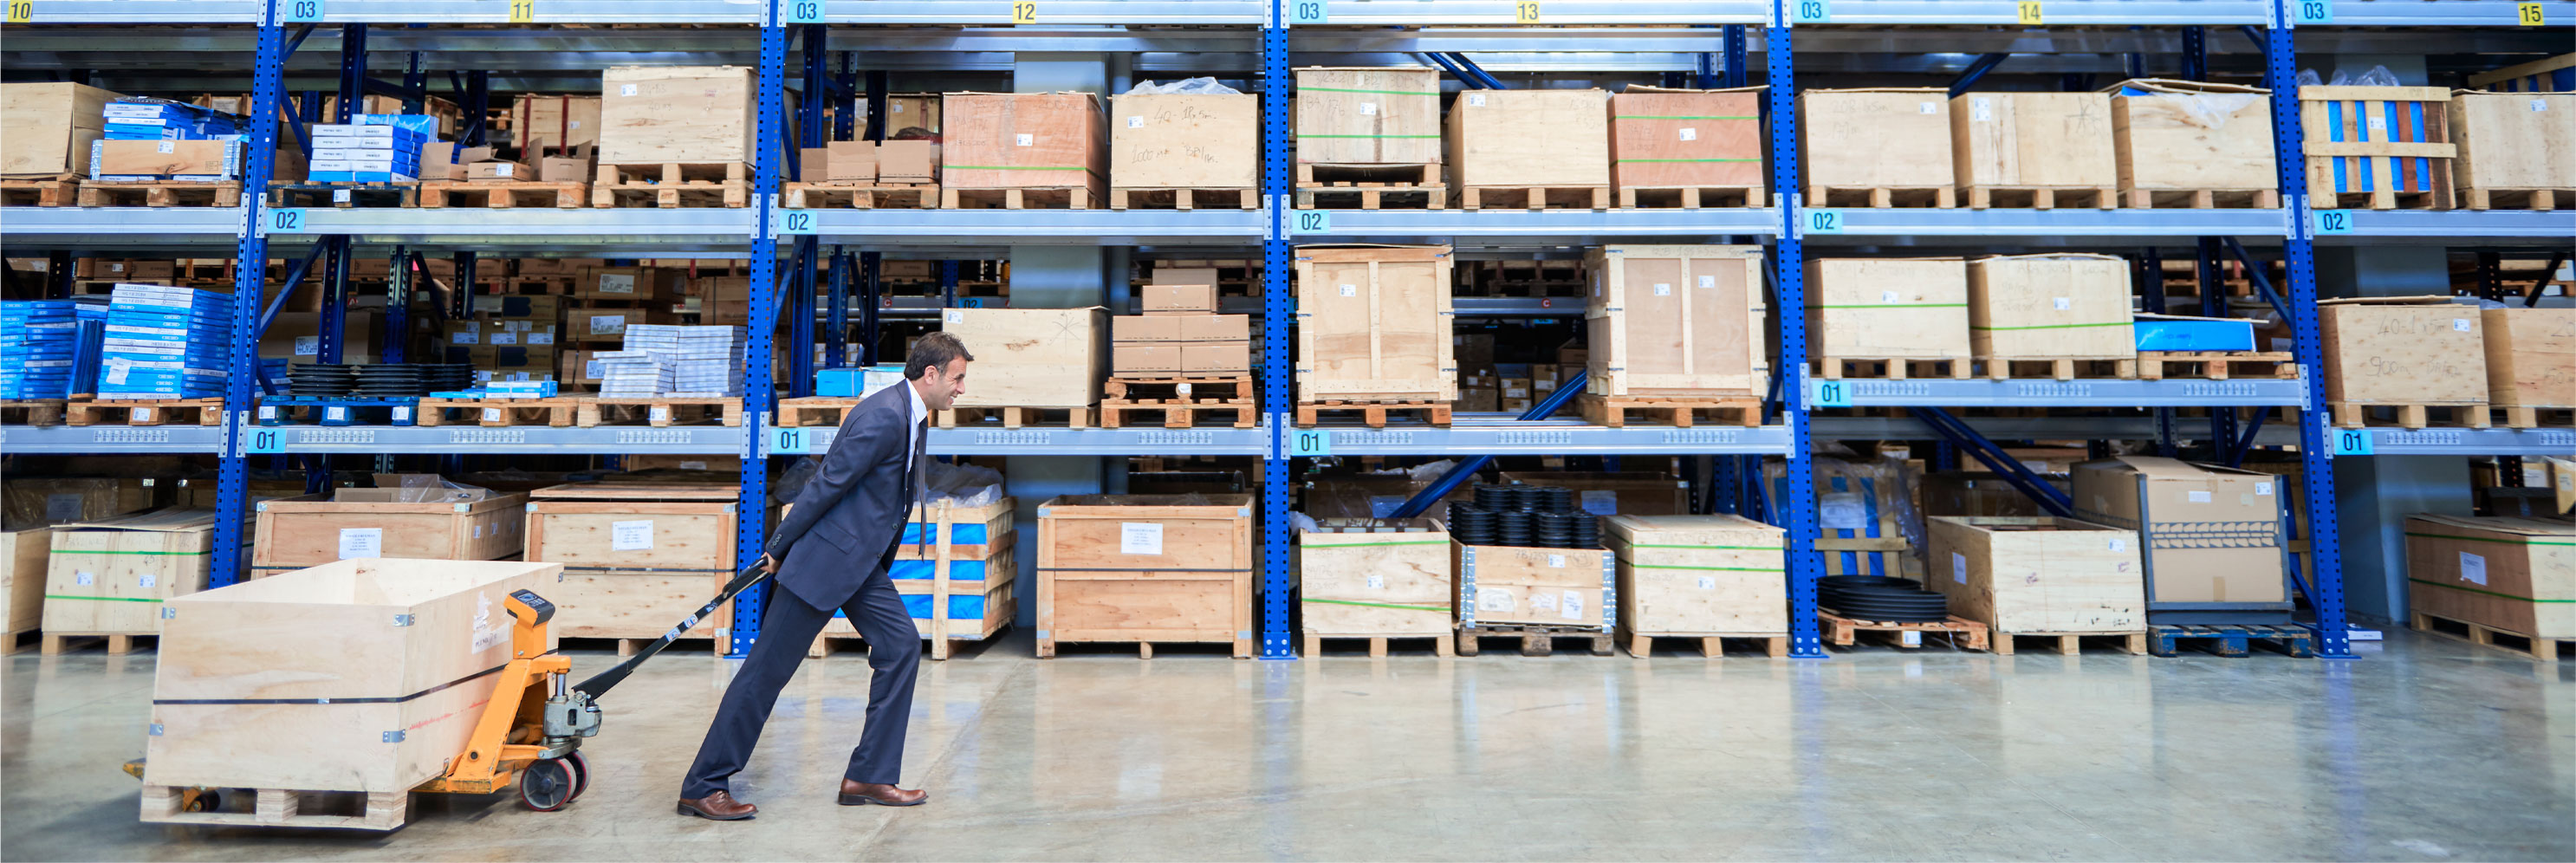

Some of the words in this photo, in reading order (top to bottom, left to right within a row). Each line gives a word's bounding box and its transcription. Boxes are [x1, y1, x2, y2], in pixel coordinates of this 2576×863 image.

[11, 3, 30, 19] 10
[295, 2, 316, 19] 03
[514, 3, 531, 19] 11
[796, 2, 817, 19] 03
[1015, 3, 1035, 21] 12
[1299, 3, 1320, 20] 03
[1519, 3, 1538, 21] 13
[1801, 2, 1822, 19] 03
[2020, 3, 2041, 21] 14
[2304, 3, 2325, 20] 03
[2521, 5, 2541, 23] 15
[276, 212, 296, 230] 02
[788, 213, 808, 230] 02
[1301, 212, 1322, 230] 02
[1814, 212, 1834, 230] 02
[2323, 213, 2345, 231] 02
[1821, 384, 1842, 403] 01
[256, 431, 276, 450] 01
[781, 431, 800, 451] 01
[1301, 432, 1320, 451] 01
[2343, 433, 2363, 452] 01
